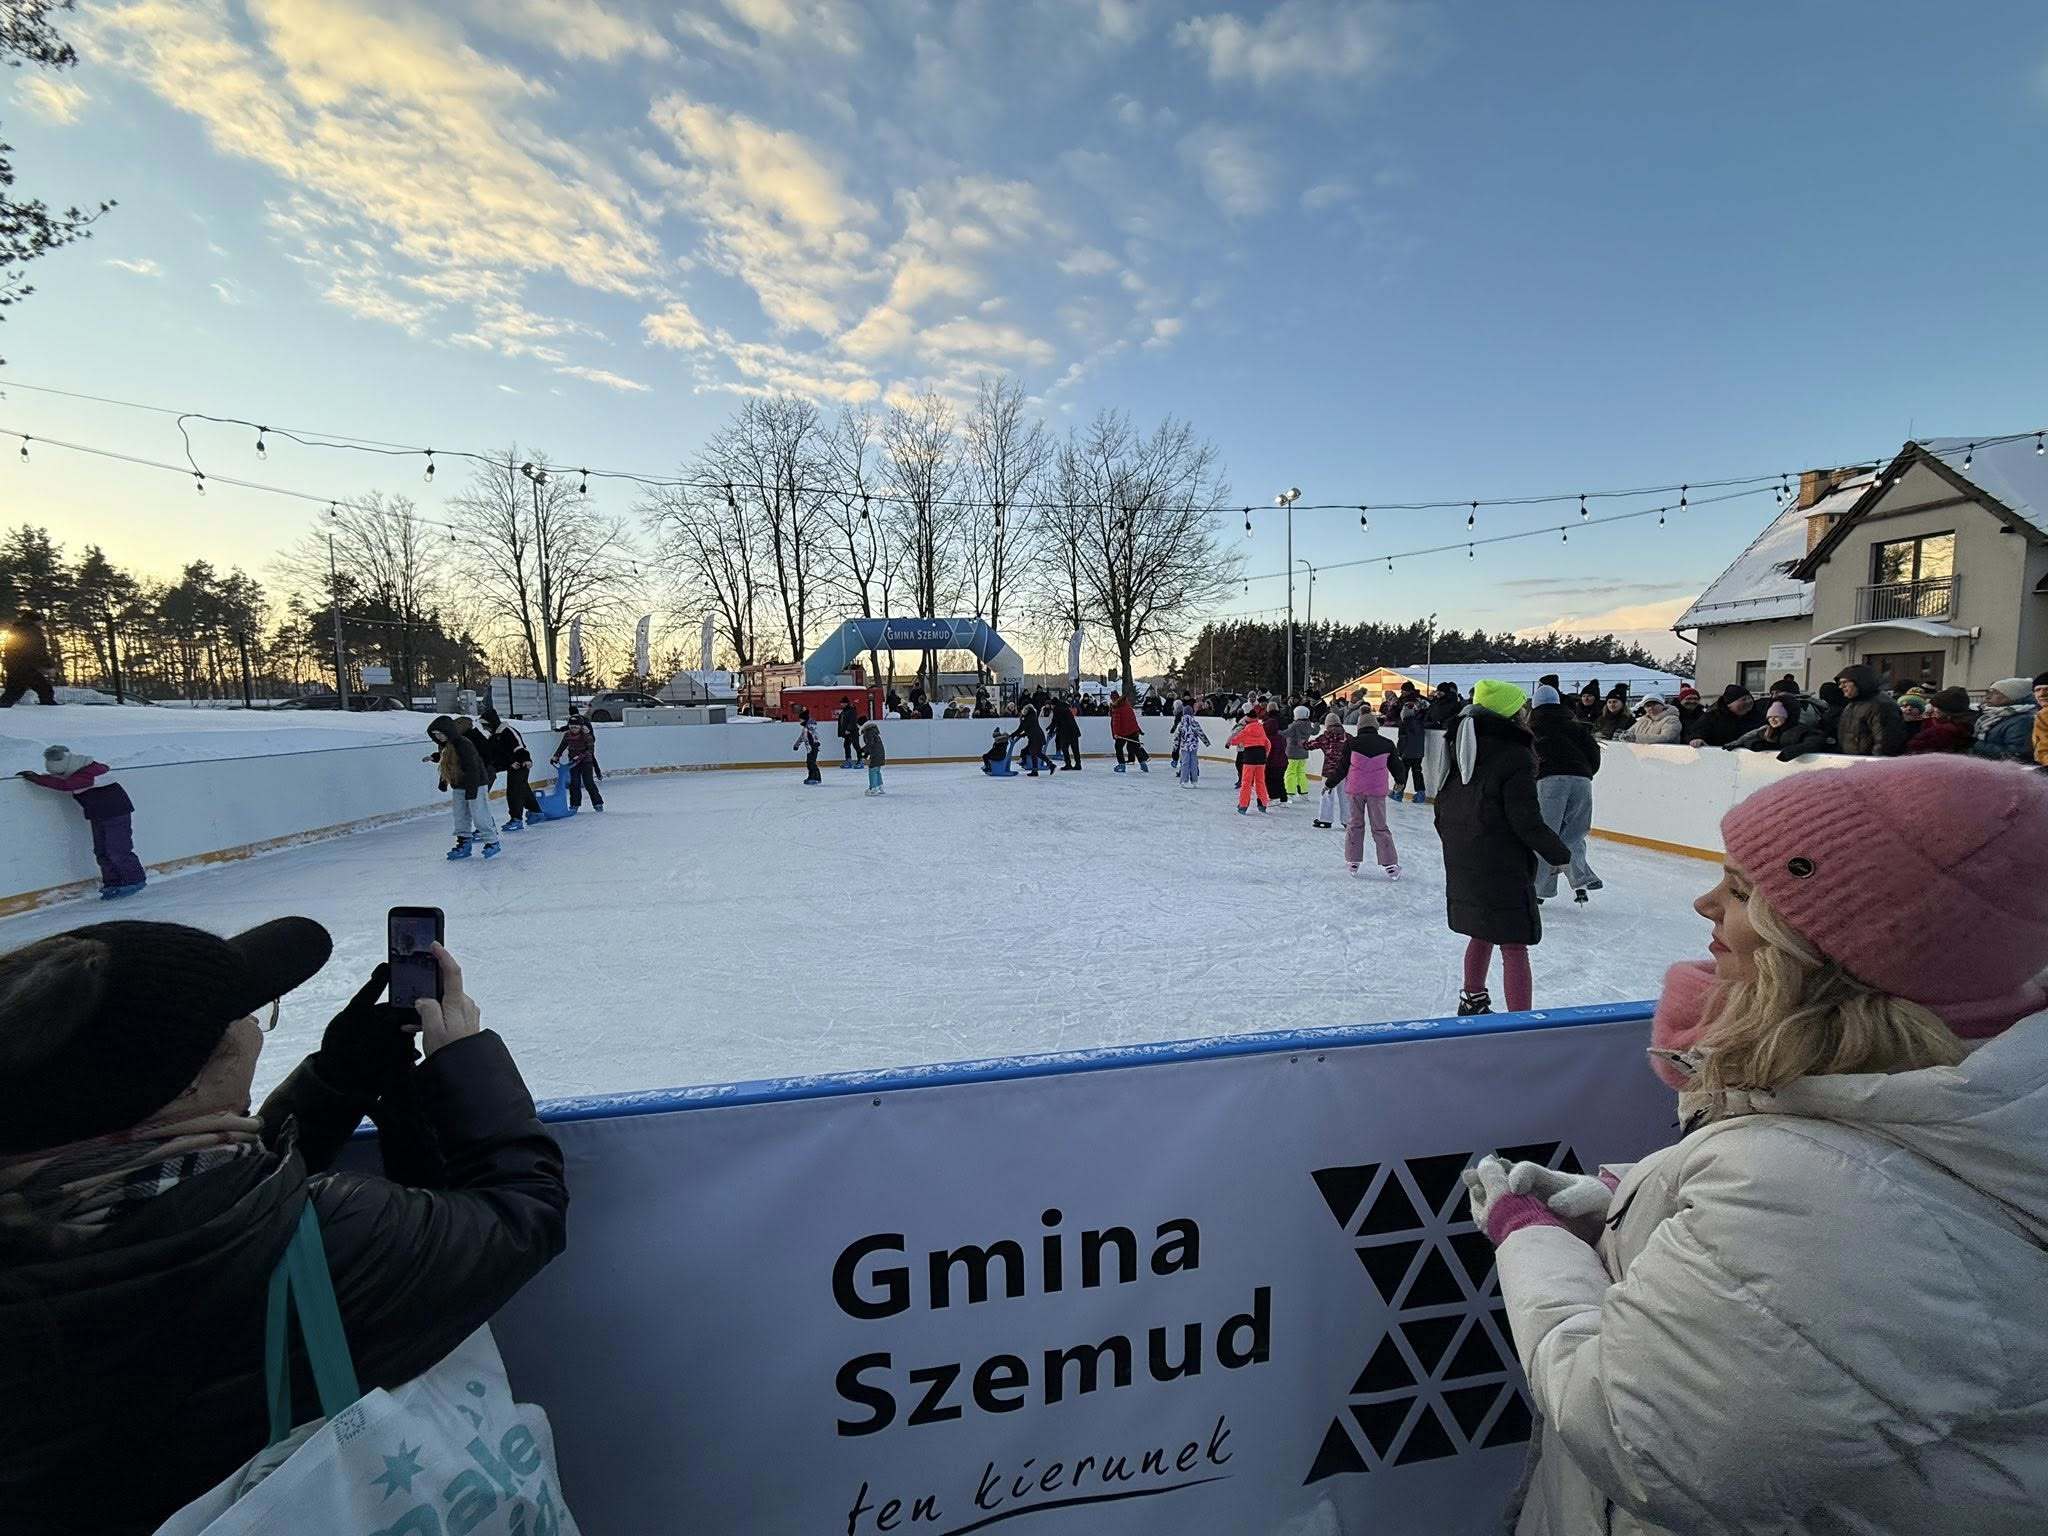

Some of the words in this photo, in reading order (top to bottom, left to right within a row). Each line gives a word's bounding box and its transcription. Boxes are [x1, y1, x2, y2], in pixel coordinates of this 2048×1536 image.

[887, 630, 915, 640] GMINA
[917, 629, 950, 640] SZEMUD
[832, 1208, 1200, 1320] Gmina
[835, 1286, 1271, 1437] Szemud
[847, 1482, 943, 1536] ten
[974, 1414, 1234, 1510] kierunek
